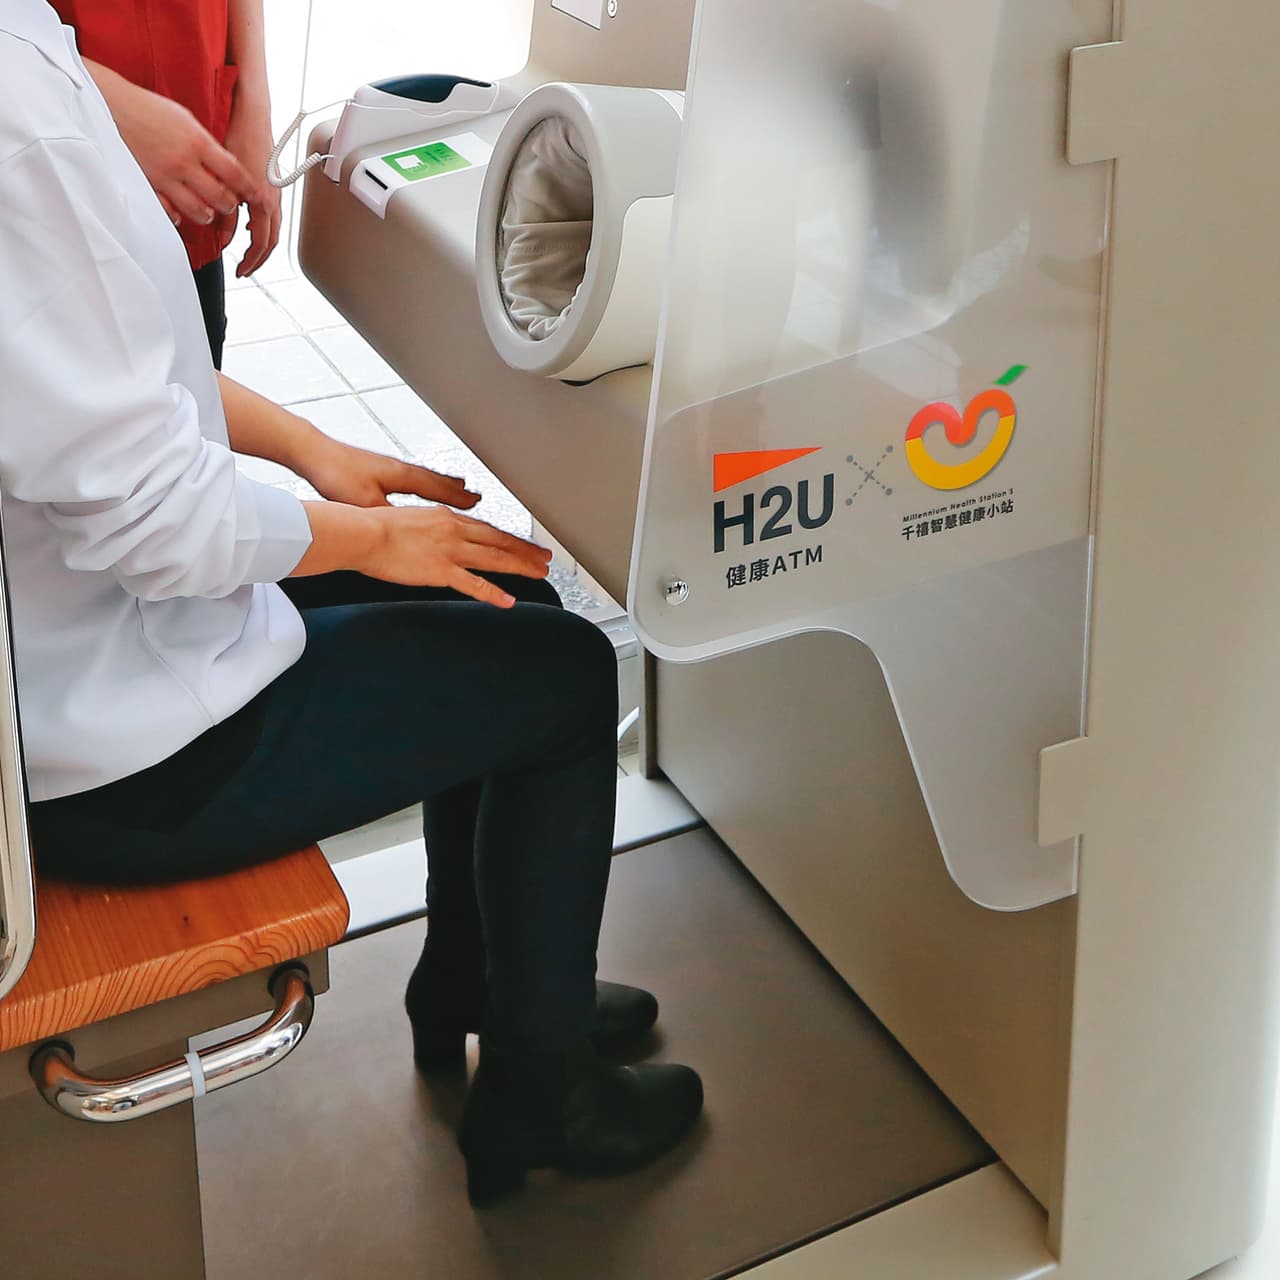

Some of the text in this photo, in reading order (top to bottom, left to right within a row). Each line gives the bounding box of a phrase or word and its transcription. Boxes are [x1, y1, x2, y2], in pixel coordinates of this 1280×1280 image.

[713, 473, 835, 553] H2U
[902, 499, 1014, 540] 千禧智慧健康小站
[903, 506, 947, 522] Millennium
[950, 498, 977, 510] Health
[979, 491, 1007, 503] Station
[725, 545, 823, 589] 健康ATM
